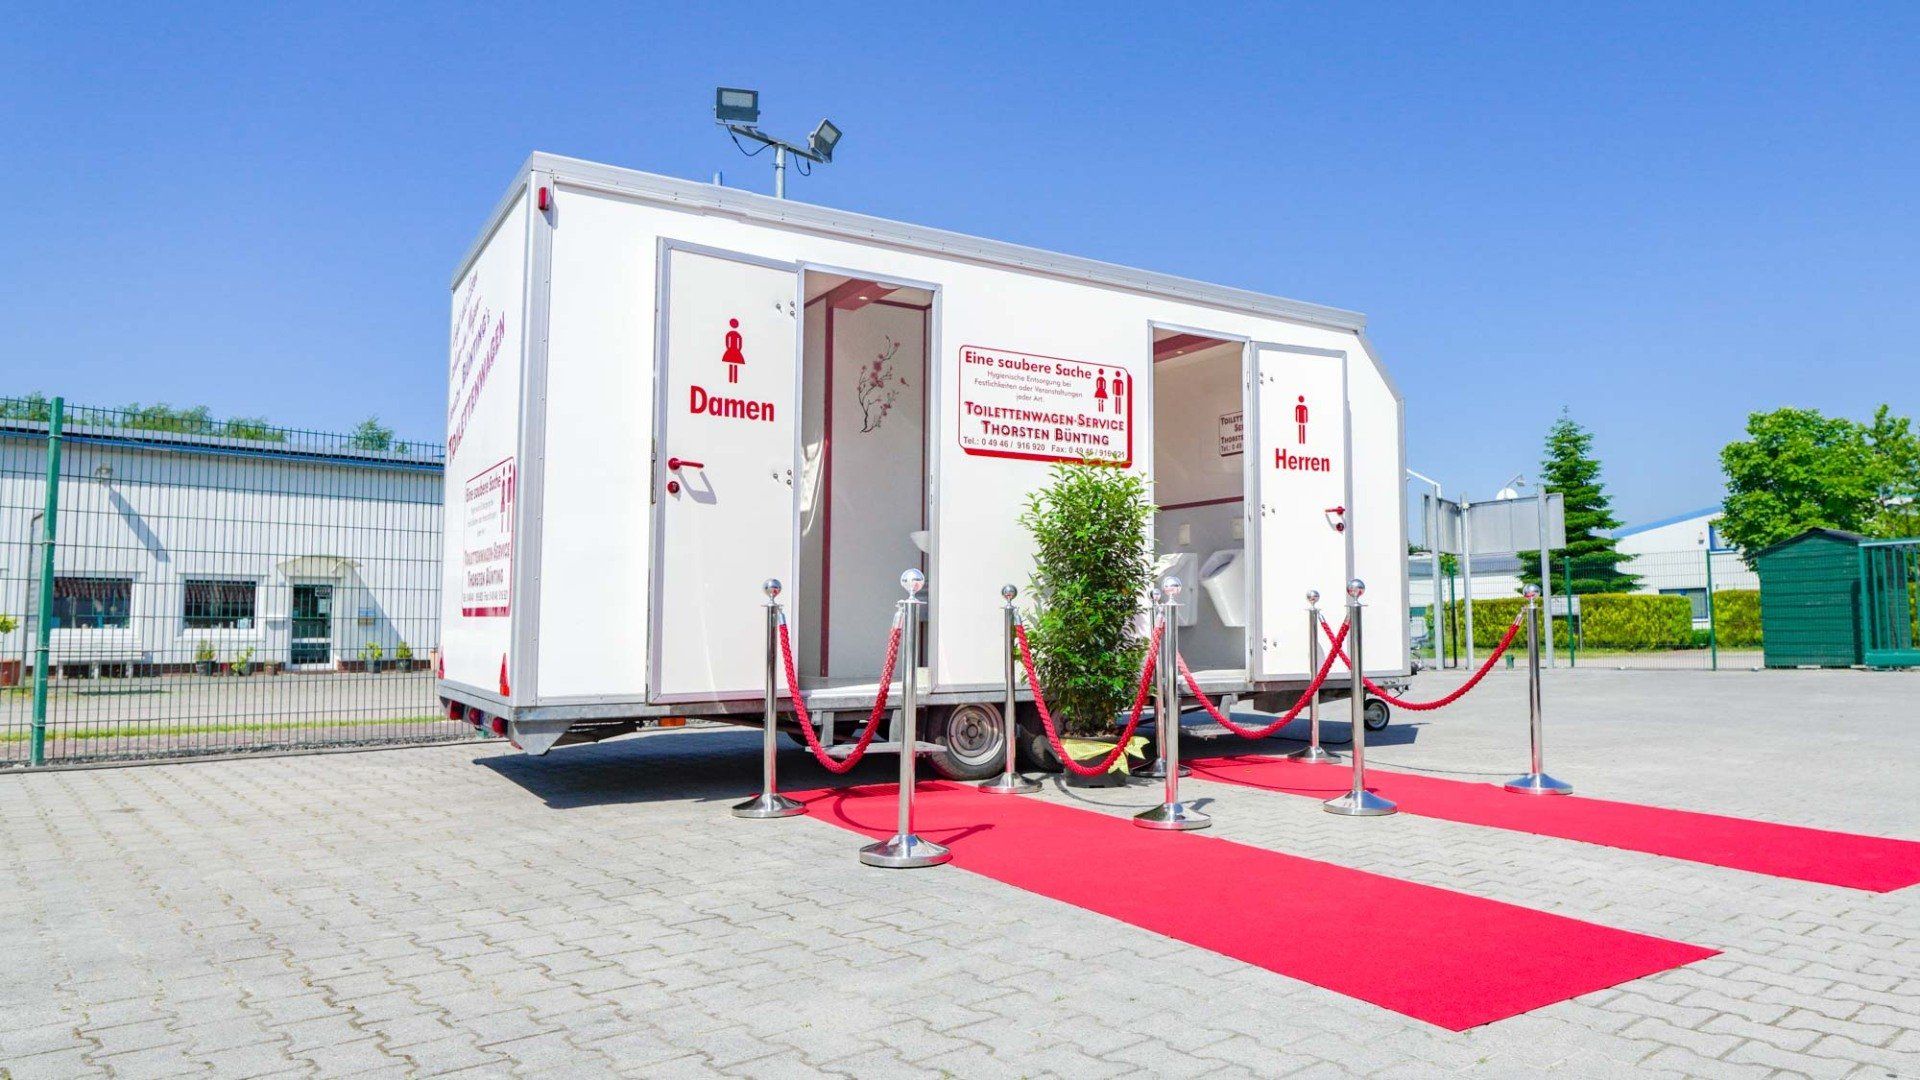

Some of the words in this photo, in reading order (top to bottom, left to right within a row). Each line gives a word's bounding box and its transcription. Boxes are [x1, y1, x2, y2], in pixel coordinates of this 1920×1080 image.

[965, 350, 994, 367] Eine
[998, 356, 1052, 374] saubere
[1055, 363, 1092, 379] Sache
[974, 378, 1016, 390] Festlichkeiten
[1018, 383, 1033, 392] oder
[1035, 386, 1083, 398] Veranstaltungen
[987, 370, 1025, 382] Hygienische
[1026, 375, 1061, 388] Entsorgung
[1062, 379, 1072, 388] bei
[690, 385, 775, 422] Damen
[1016, 393, 1032, 402] jeder
[981, 420, 1050, 440] THORSTEN
[1055, 427, 1110, 446] BÜNTING
[963, 436, 980, 445] Tel.:
[981, 437, 987, 446] 0
[988, 438, 998, 447] 49
[999, 439, 1009, 448] 46
[1017, 441, 1031, 450] 916
[1032, 442, 1046, 451] 920
[1051, 444, 1068, 453] Fax:
[1275, 448, 1330, 472] Herren
